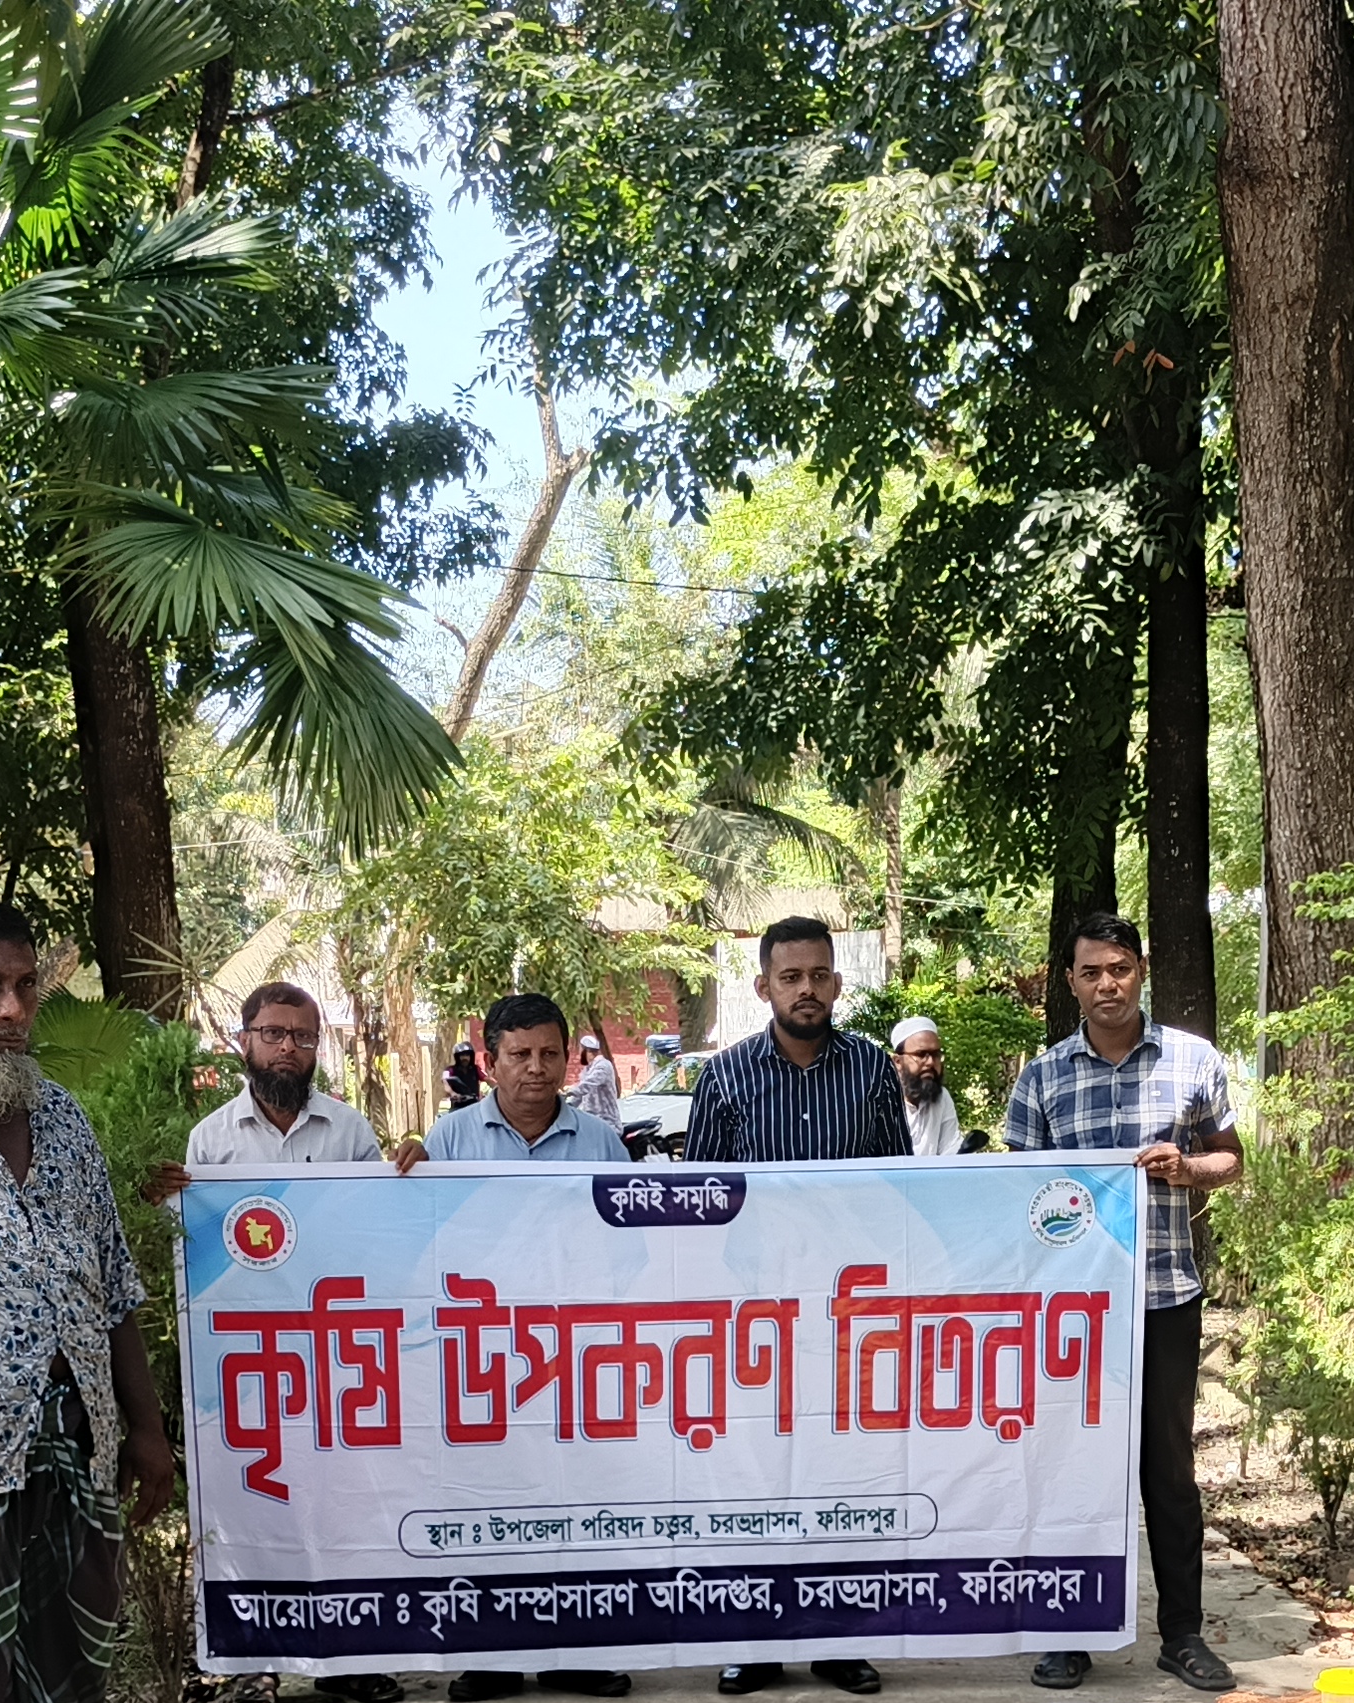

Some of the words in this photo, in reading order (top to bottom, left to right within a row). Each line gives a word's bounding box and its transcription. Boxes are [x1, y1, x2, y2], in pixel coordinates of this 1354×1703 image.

[607, 1177, 667, 1223] কৃষিই
[670, 1176, 732, 1221] সমৃদ্ধি
[211, 1274, 405, 1504] কৃষি
[433, 1271, 800, 1452] উপকরণ
[827, 1263, 1111, 1442] বিতরণ
[424, 1521, 464, 1551] স্থান
[488, 1513, 573, 1544] উপজেলা
[580, 1510, 645, 1541] পরিষদ
[708, 1508, 808, 1538] চরভদ্রাসন,
[815, 1502, 896, 1537] ফরিদপুর
[228, 1589, 384, 1630] আয়োজনে
[419, 1577, 483, 1641] কৃষি
[491, 1578, 639, 1625] সম্প্রসারণ
[646, 1567, 784, 1620] অধিদপ্তর,
[793, 1569, 947, 1615] চরভদ্রাসন,
[958, 1558, 1086, 1613] ফরিদপুর
